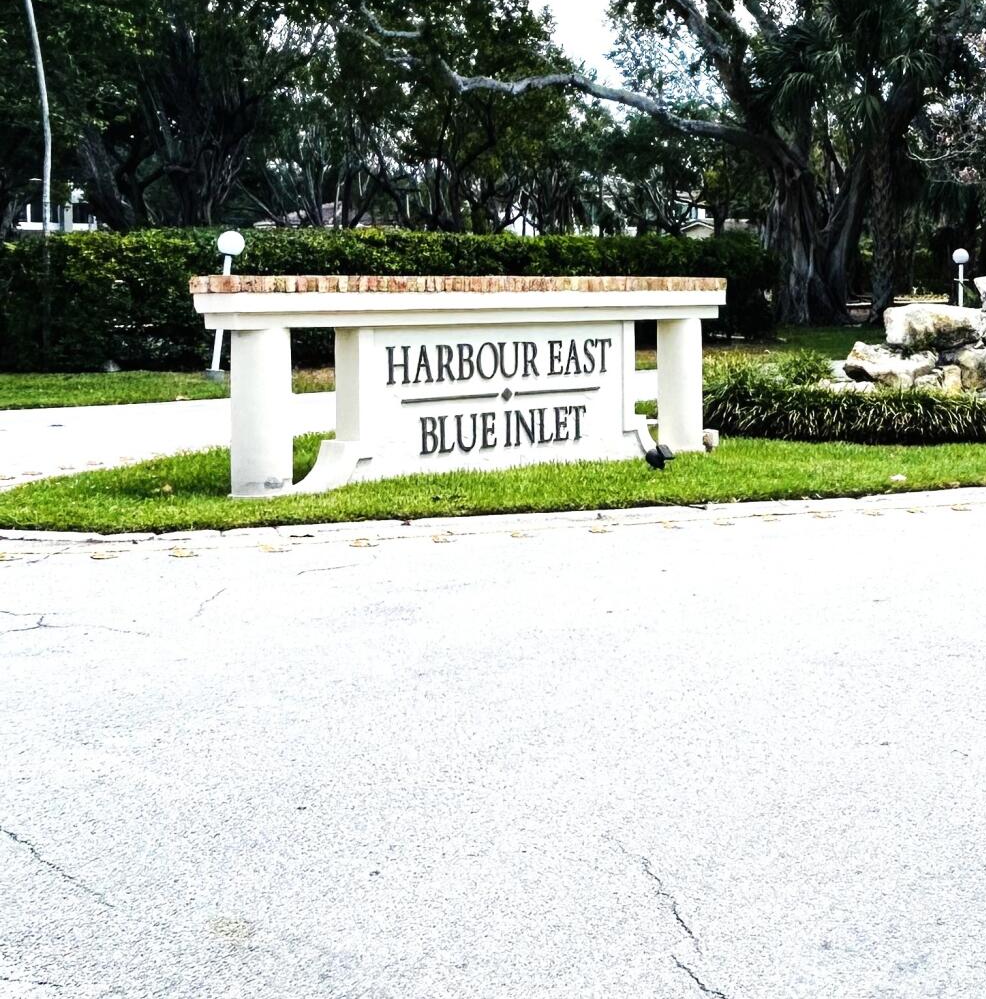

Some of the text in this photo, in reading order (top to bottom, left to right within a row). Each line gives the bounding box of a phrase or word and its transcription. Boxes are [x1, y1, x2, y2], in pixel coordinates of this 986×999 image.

[386, 338, 612, 385] HARBOUR EAST
[419, 405, 586, 455] BLUE INLET
